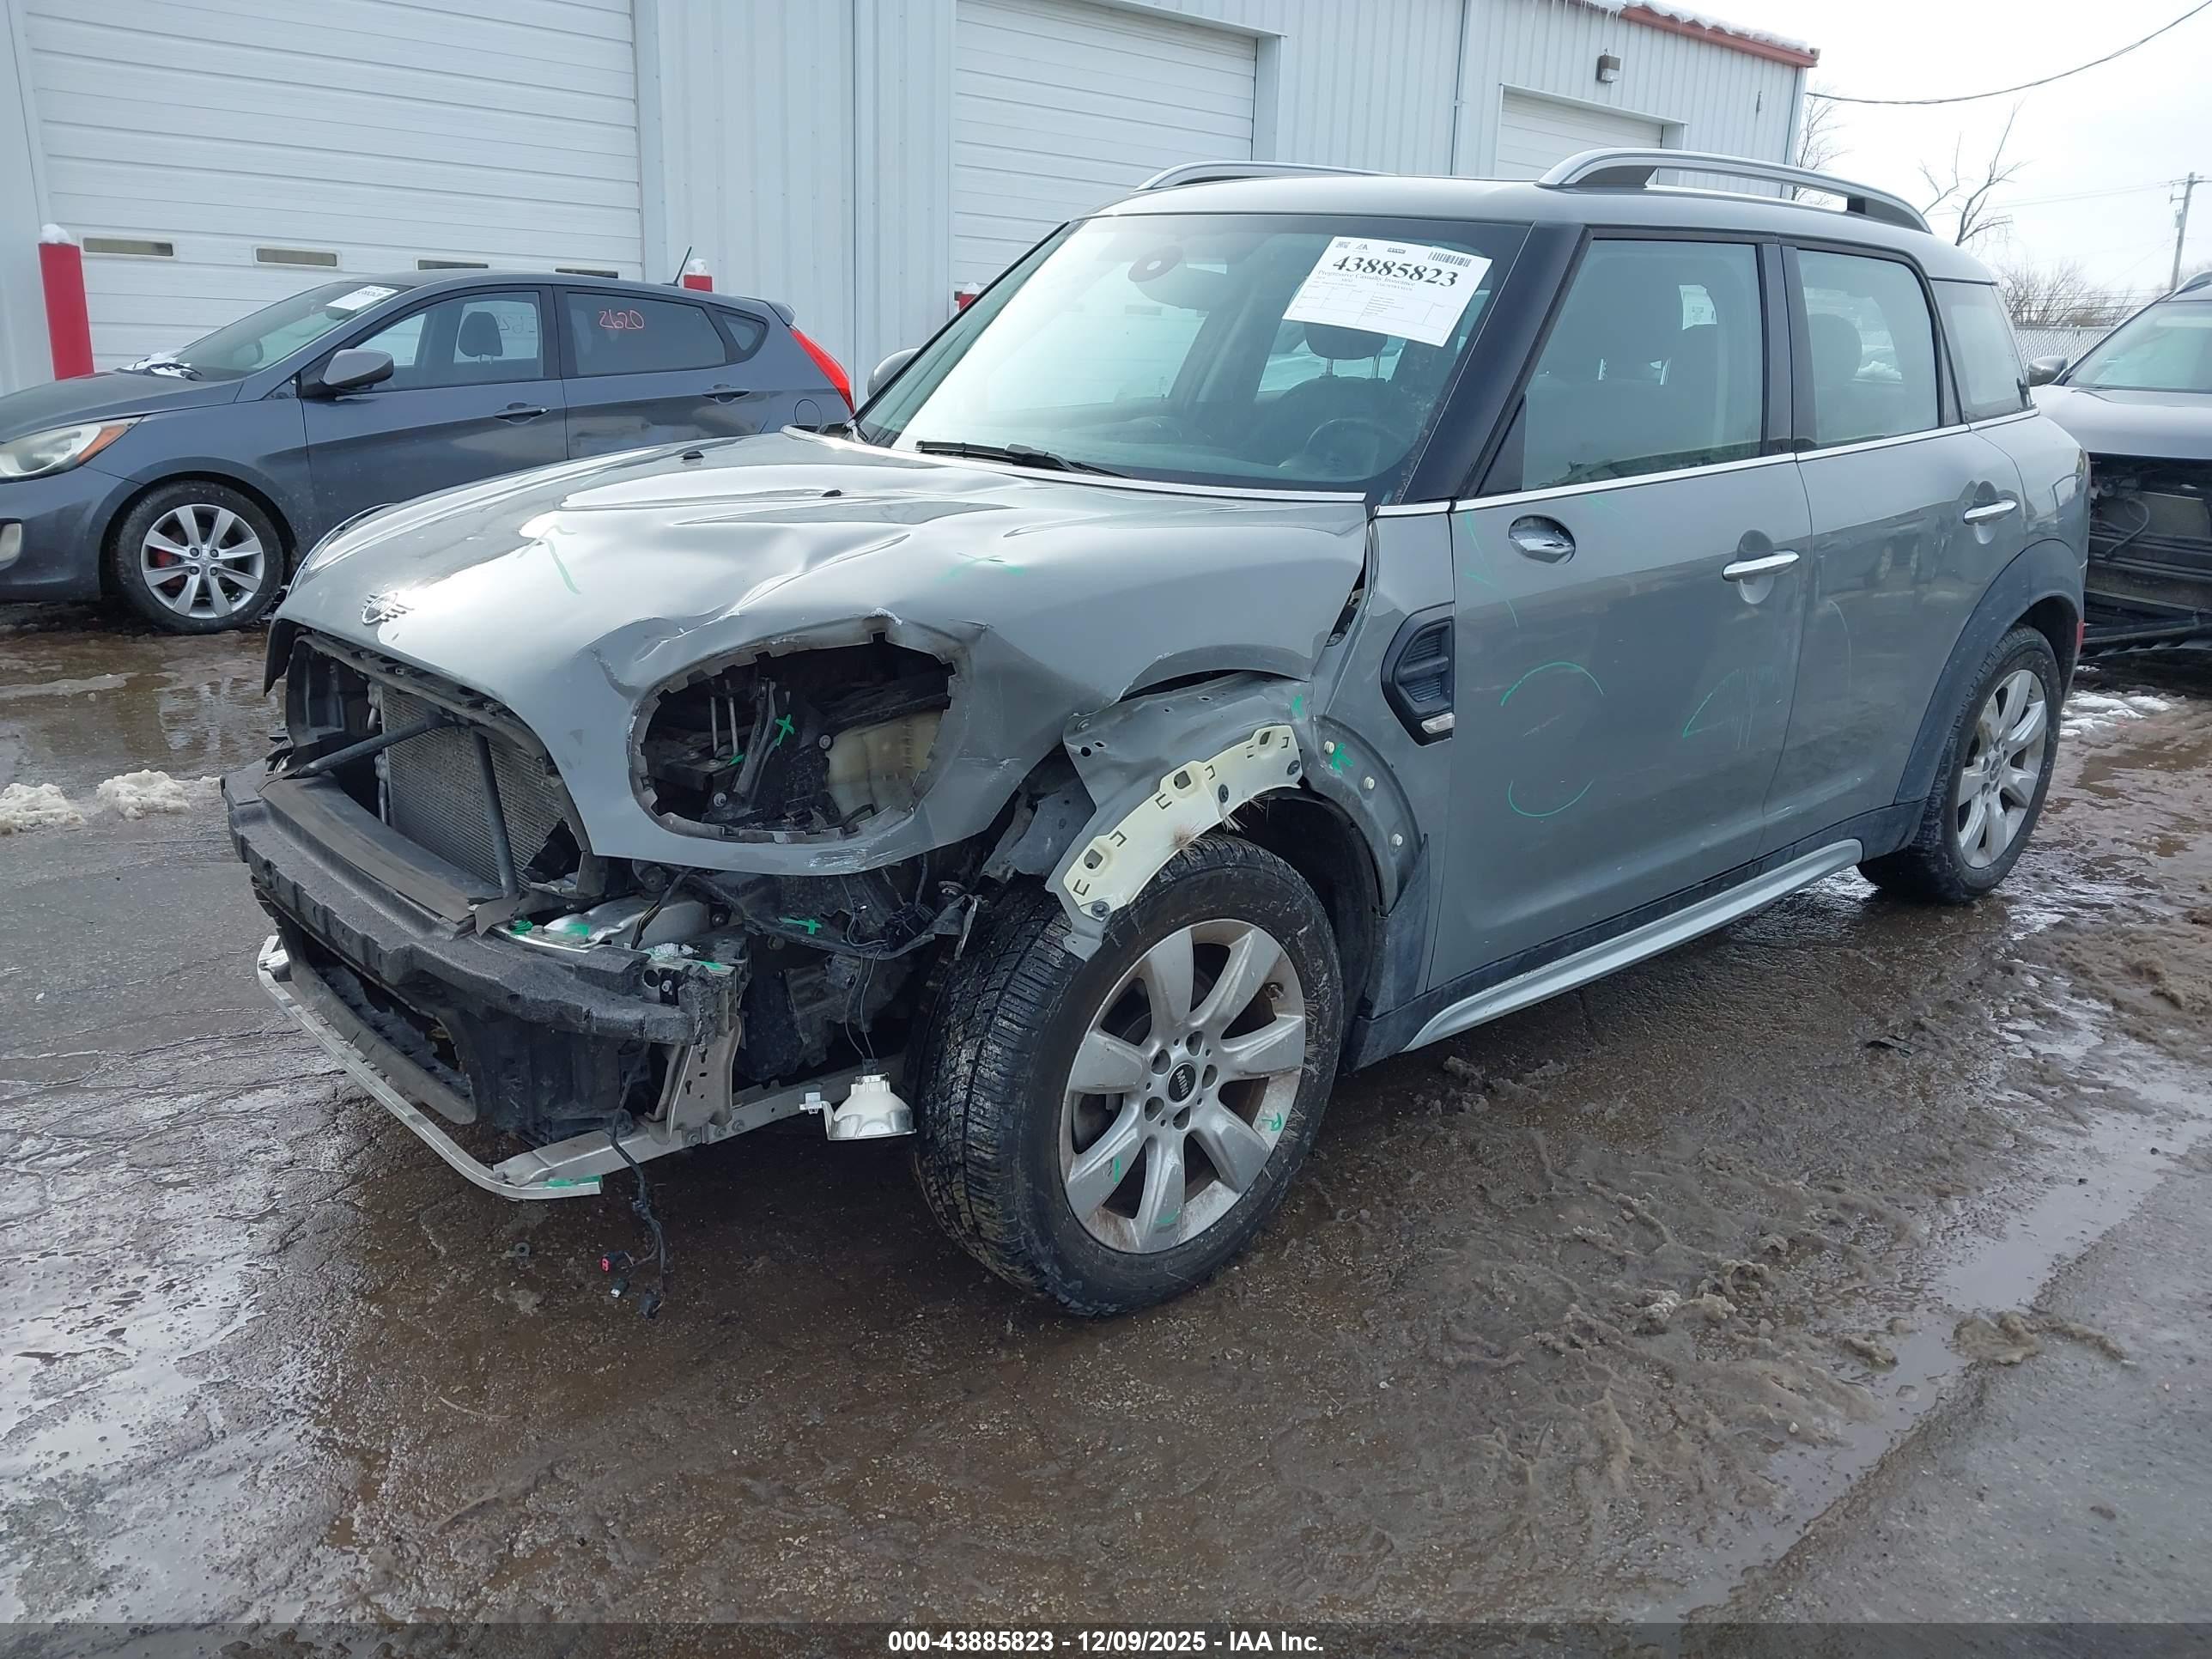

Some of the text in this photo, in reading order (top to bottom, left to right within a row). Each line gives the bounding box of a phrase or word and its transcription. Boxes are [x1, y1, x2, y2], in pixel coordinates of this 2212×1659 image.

[1333, 256, 1459, 287] 43885823
[599, 308, 644, 330] 2620
[1176, 1068, 1189, 1097] MINI
